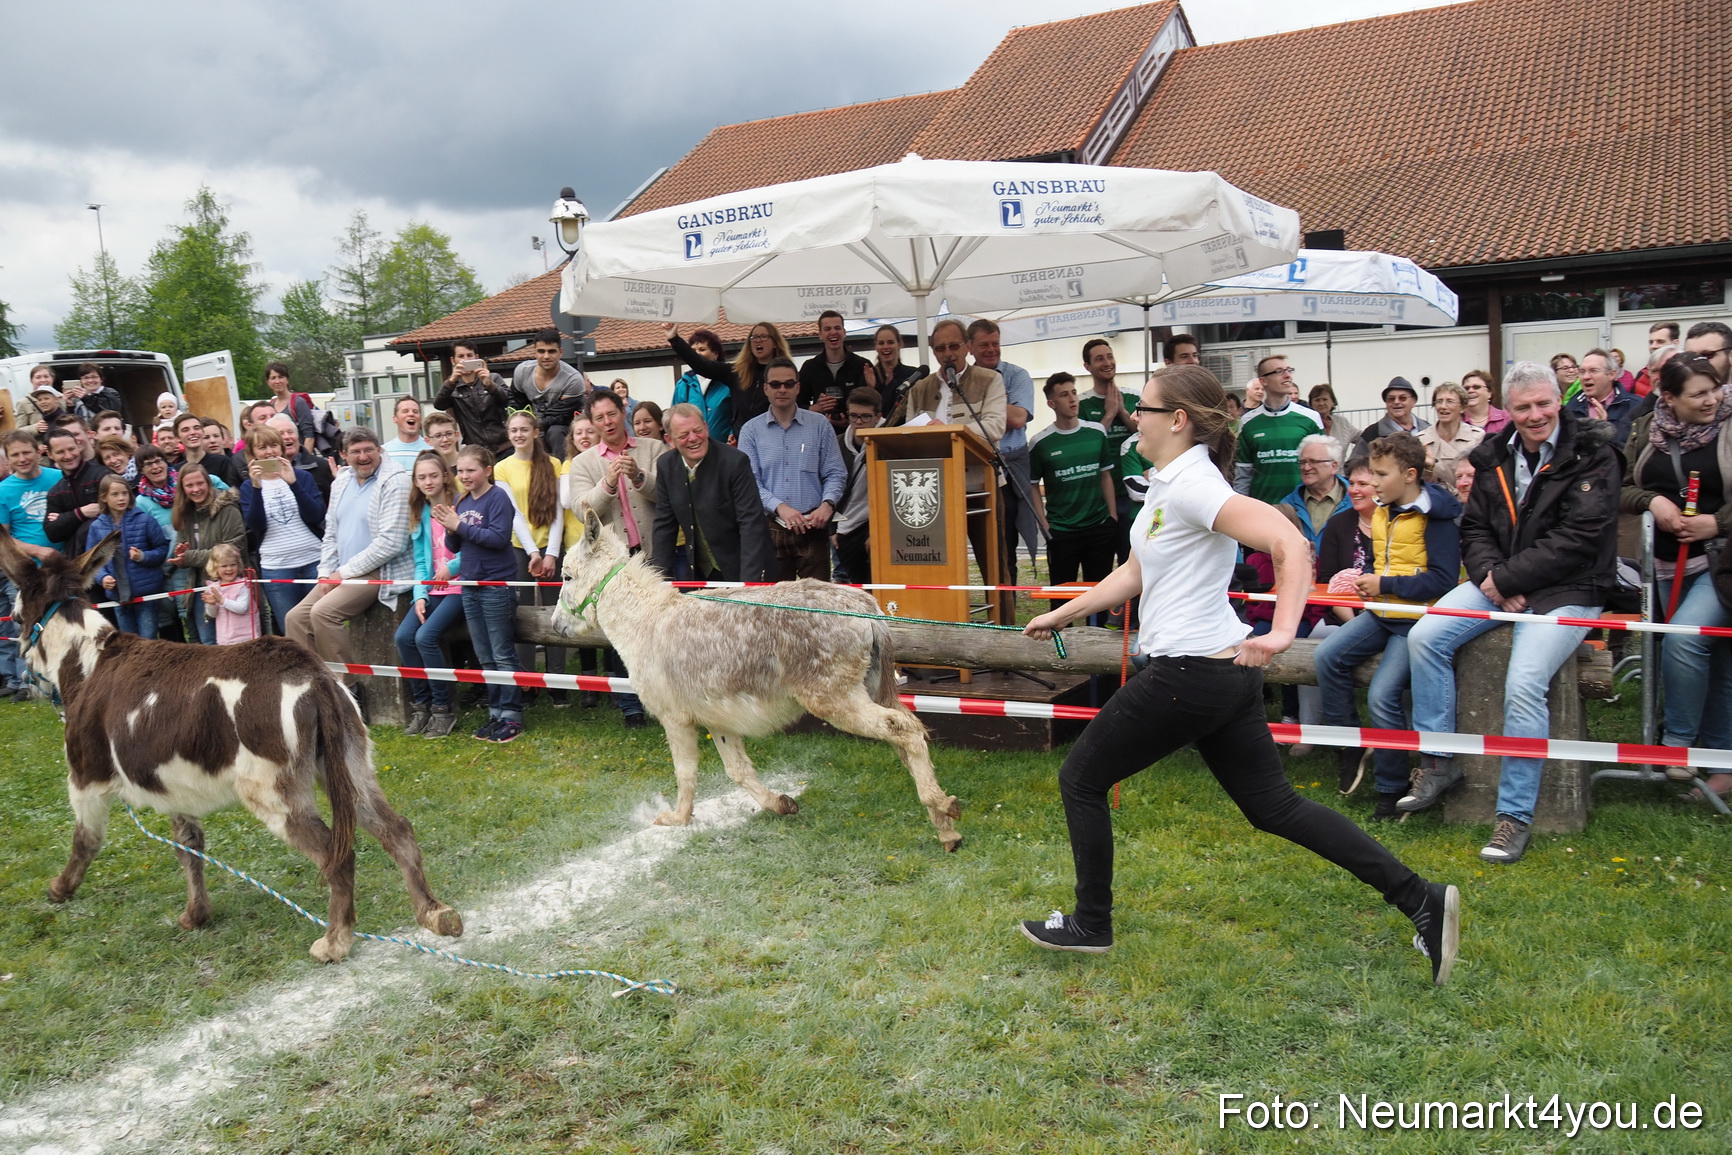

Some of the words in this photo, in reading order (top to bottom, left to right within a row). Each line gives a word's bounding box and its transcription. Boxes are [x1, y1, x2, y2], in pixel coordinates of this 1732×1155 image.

[993, 179, 1105, 196] GANSBRÄU
[677, 202, 773, 229] GANSBRÄU
[1035, 200, 1099, 216] Neumarkt's
[1033, 214, 1060, 227] guter
[1061, 213, 1105, 226] Schluck
[713, 226, 767, 246] Neumarkt's
[709, 245, 733, 257] guter
[733, 237, 770, 253] Schluck
[1054, 466, 1075, 478] Karl
[1075, 462, 1100, 472] Seger
[905, 534, 930, 548] Stadt
[896, 549, 942, 562] Neumarkt
